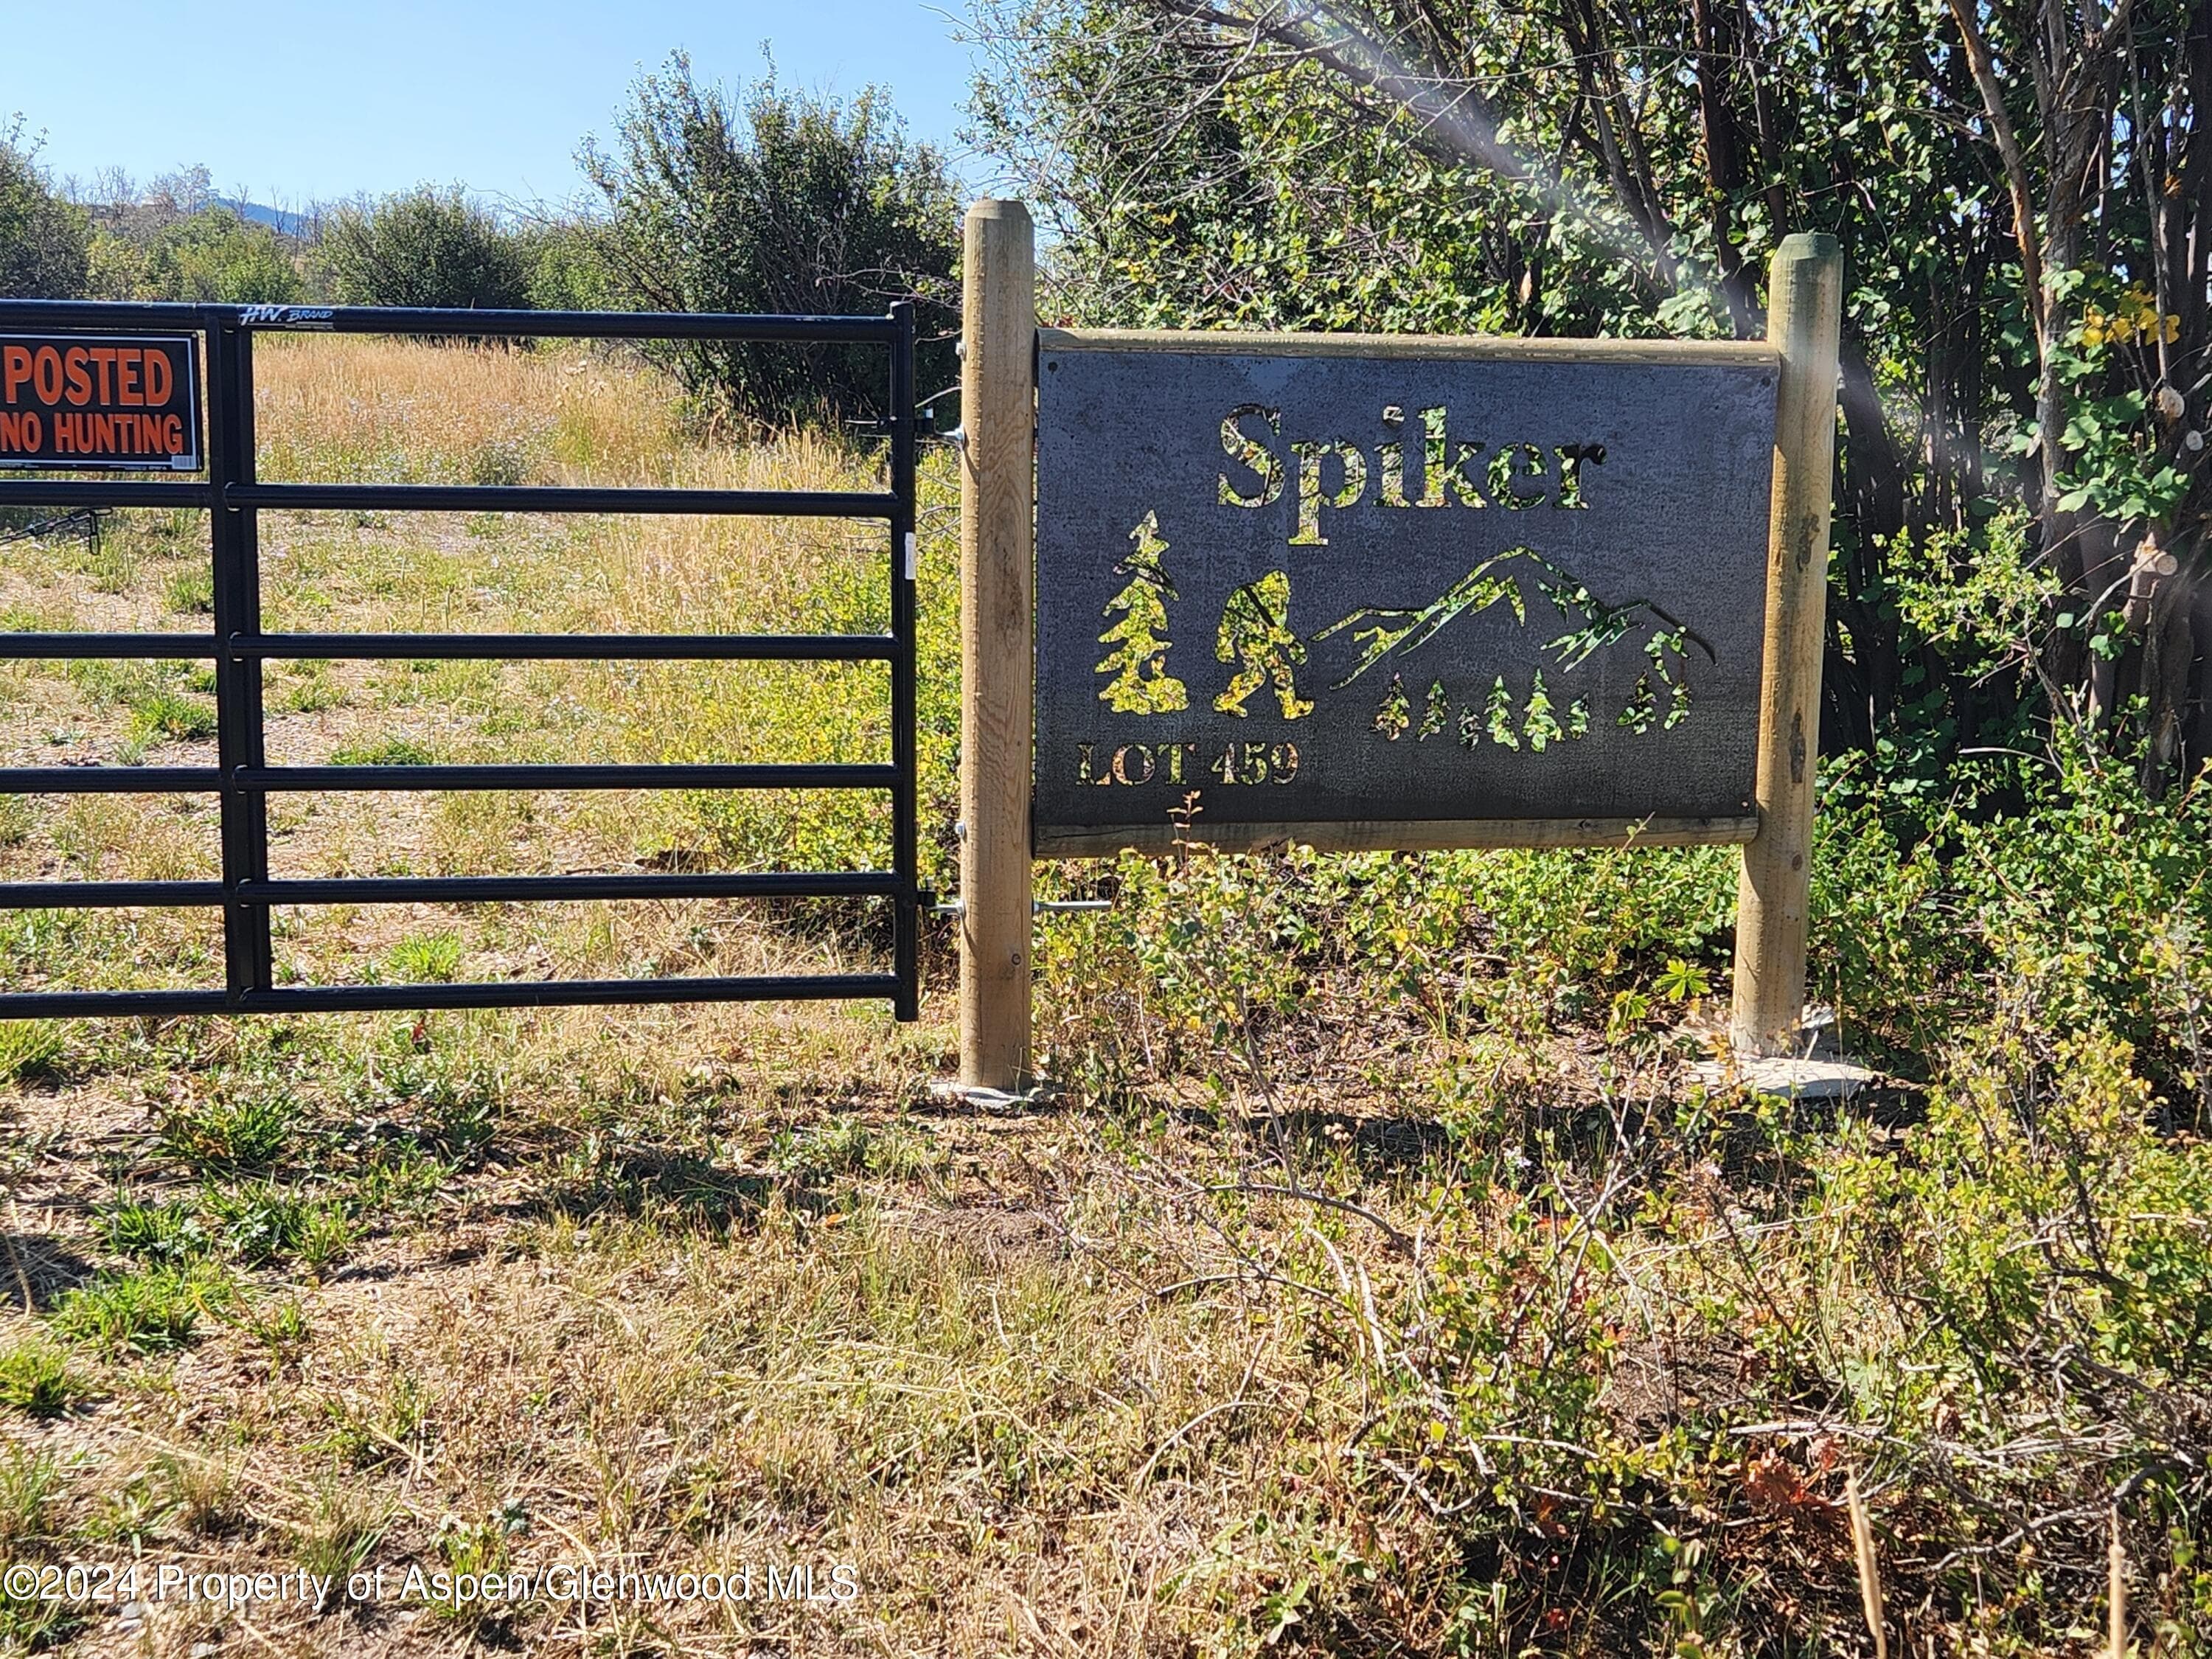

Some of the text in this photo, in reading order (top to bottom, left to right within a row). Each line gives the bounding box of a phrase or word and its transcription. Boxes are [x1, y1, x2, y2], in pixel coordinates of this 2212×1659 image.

[287, 309, 333, 322] BRAND
[4, 345, 173, 406] POSTED
[0, 411, 183, 454] NO HUNTING
[1217, 403, 1607, 546] Spiker
[1076, 742, 1298, 786] LOT 459
